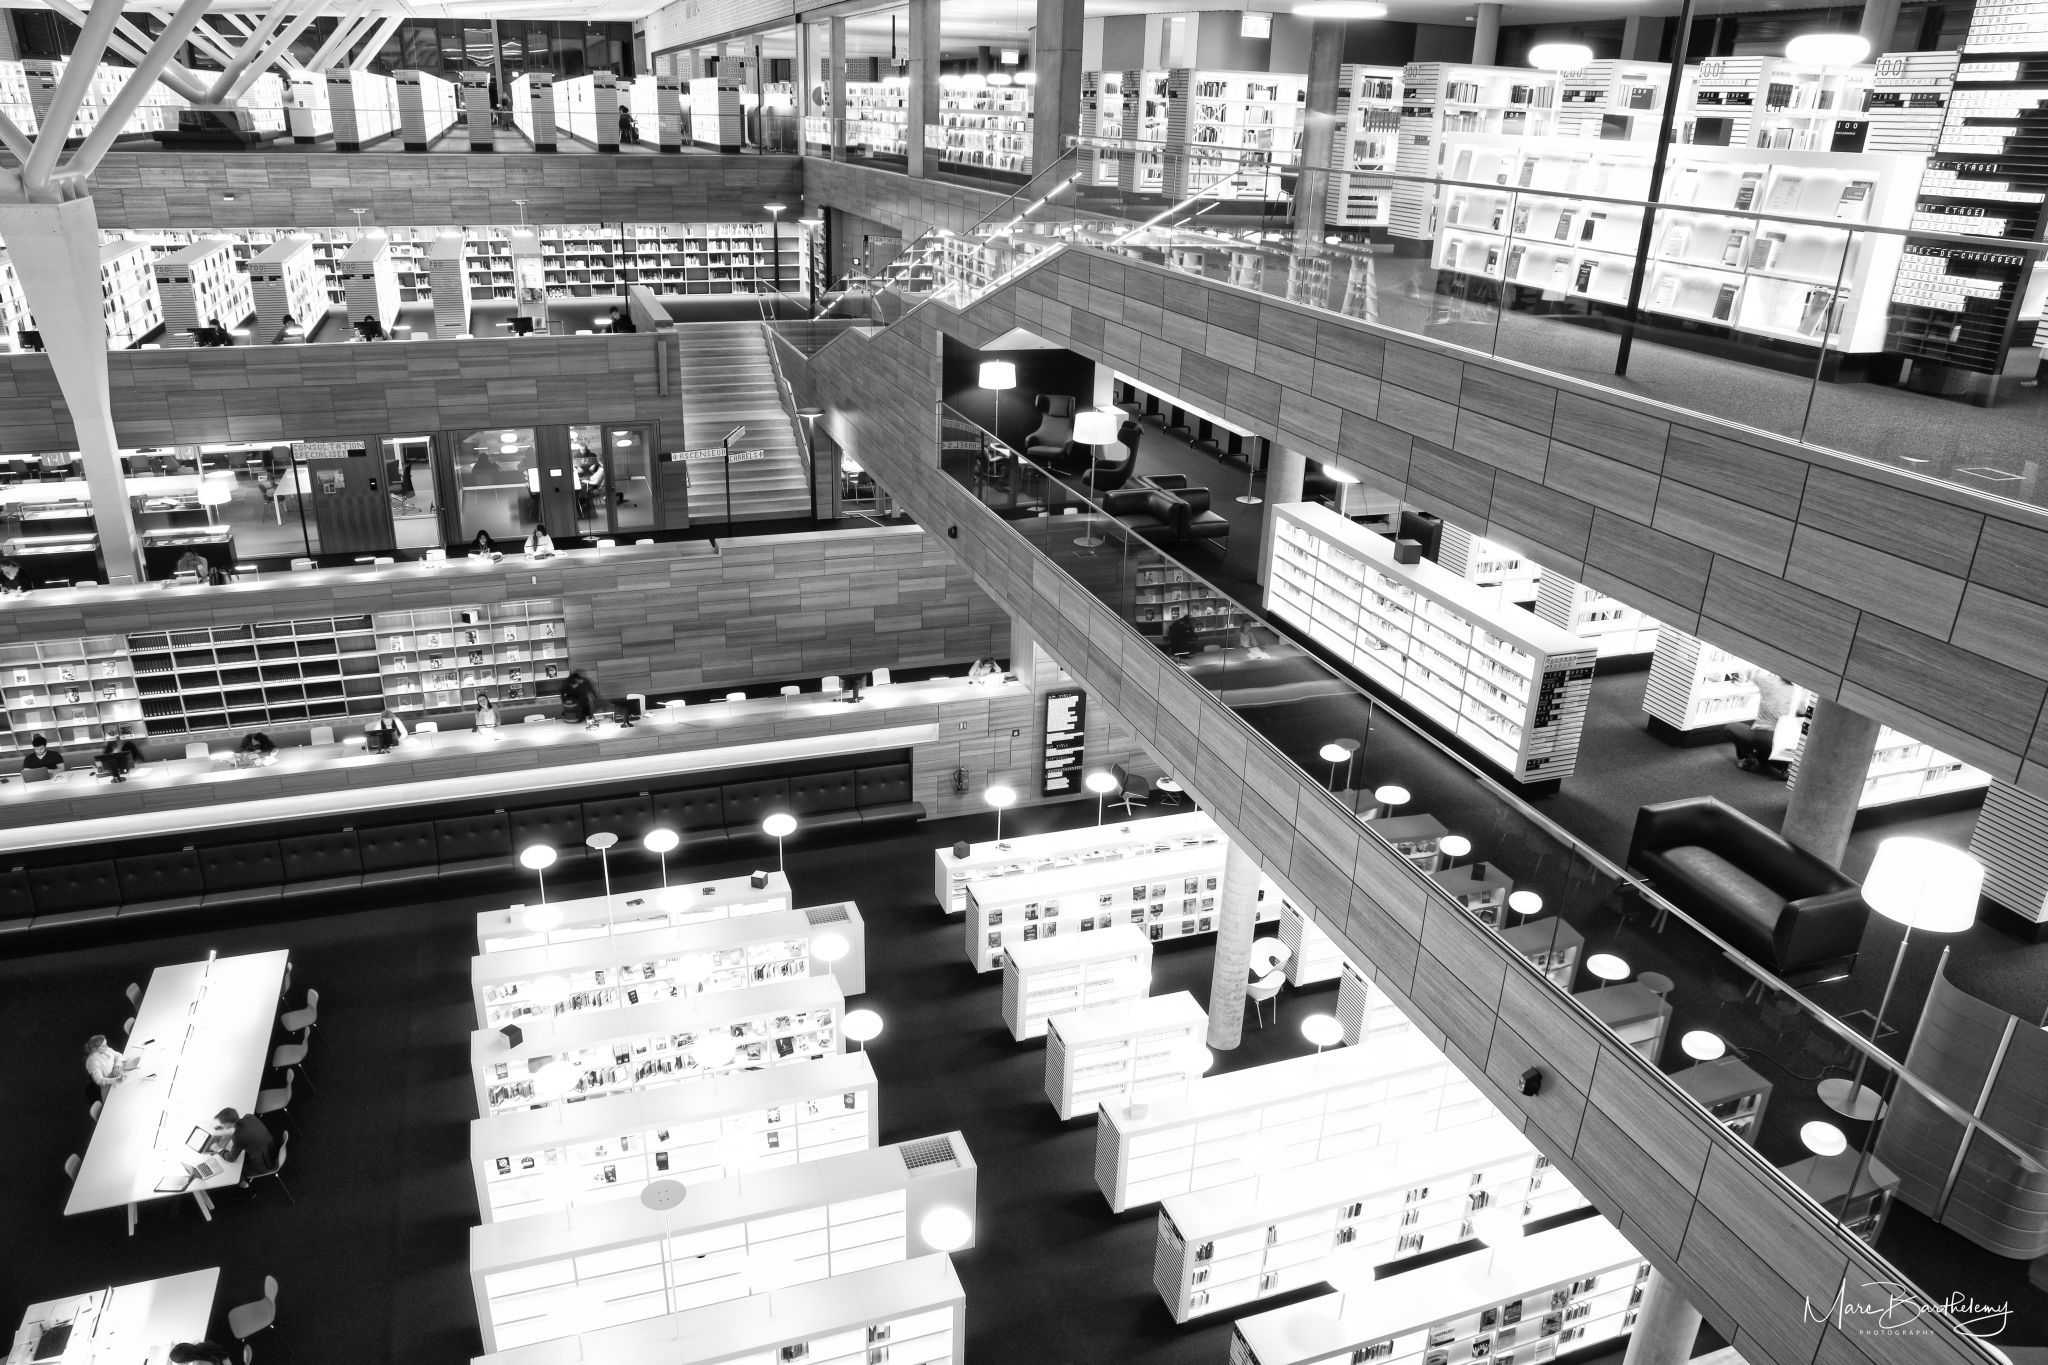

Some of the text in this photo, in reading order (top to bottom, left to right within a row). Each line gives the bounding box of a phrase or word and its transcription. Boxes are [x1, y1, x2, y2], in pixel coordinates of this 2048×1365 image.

[1972, 16, 2009, 25] LIVRE
[1698, 62, 1720, 77] 100
[1874, 60, 1902, 77] 100
[1900, 263, 1941, 274] PRESSE
[1899, 271, 1968, 286] NOUVEAUTES
[1895, 287, 1935, 299] ESPACE
[1893, 296, 1961, 311] DECOUVERTE
[293, 441, 365, 452] CONSULTATION
[679, 448, 758, 463] ASCENSEUR CARRELS
